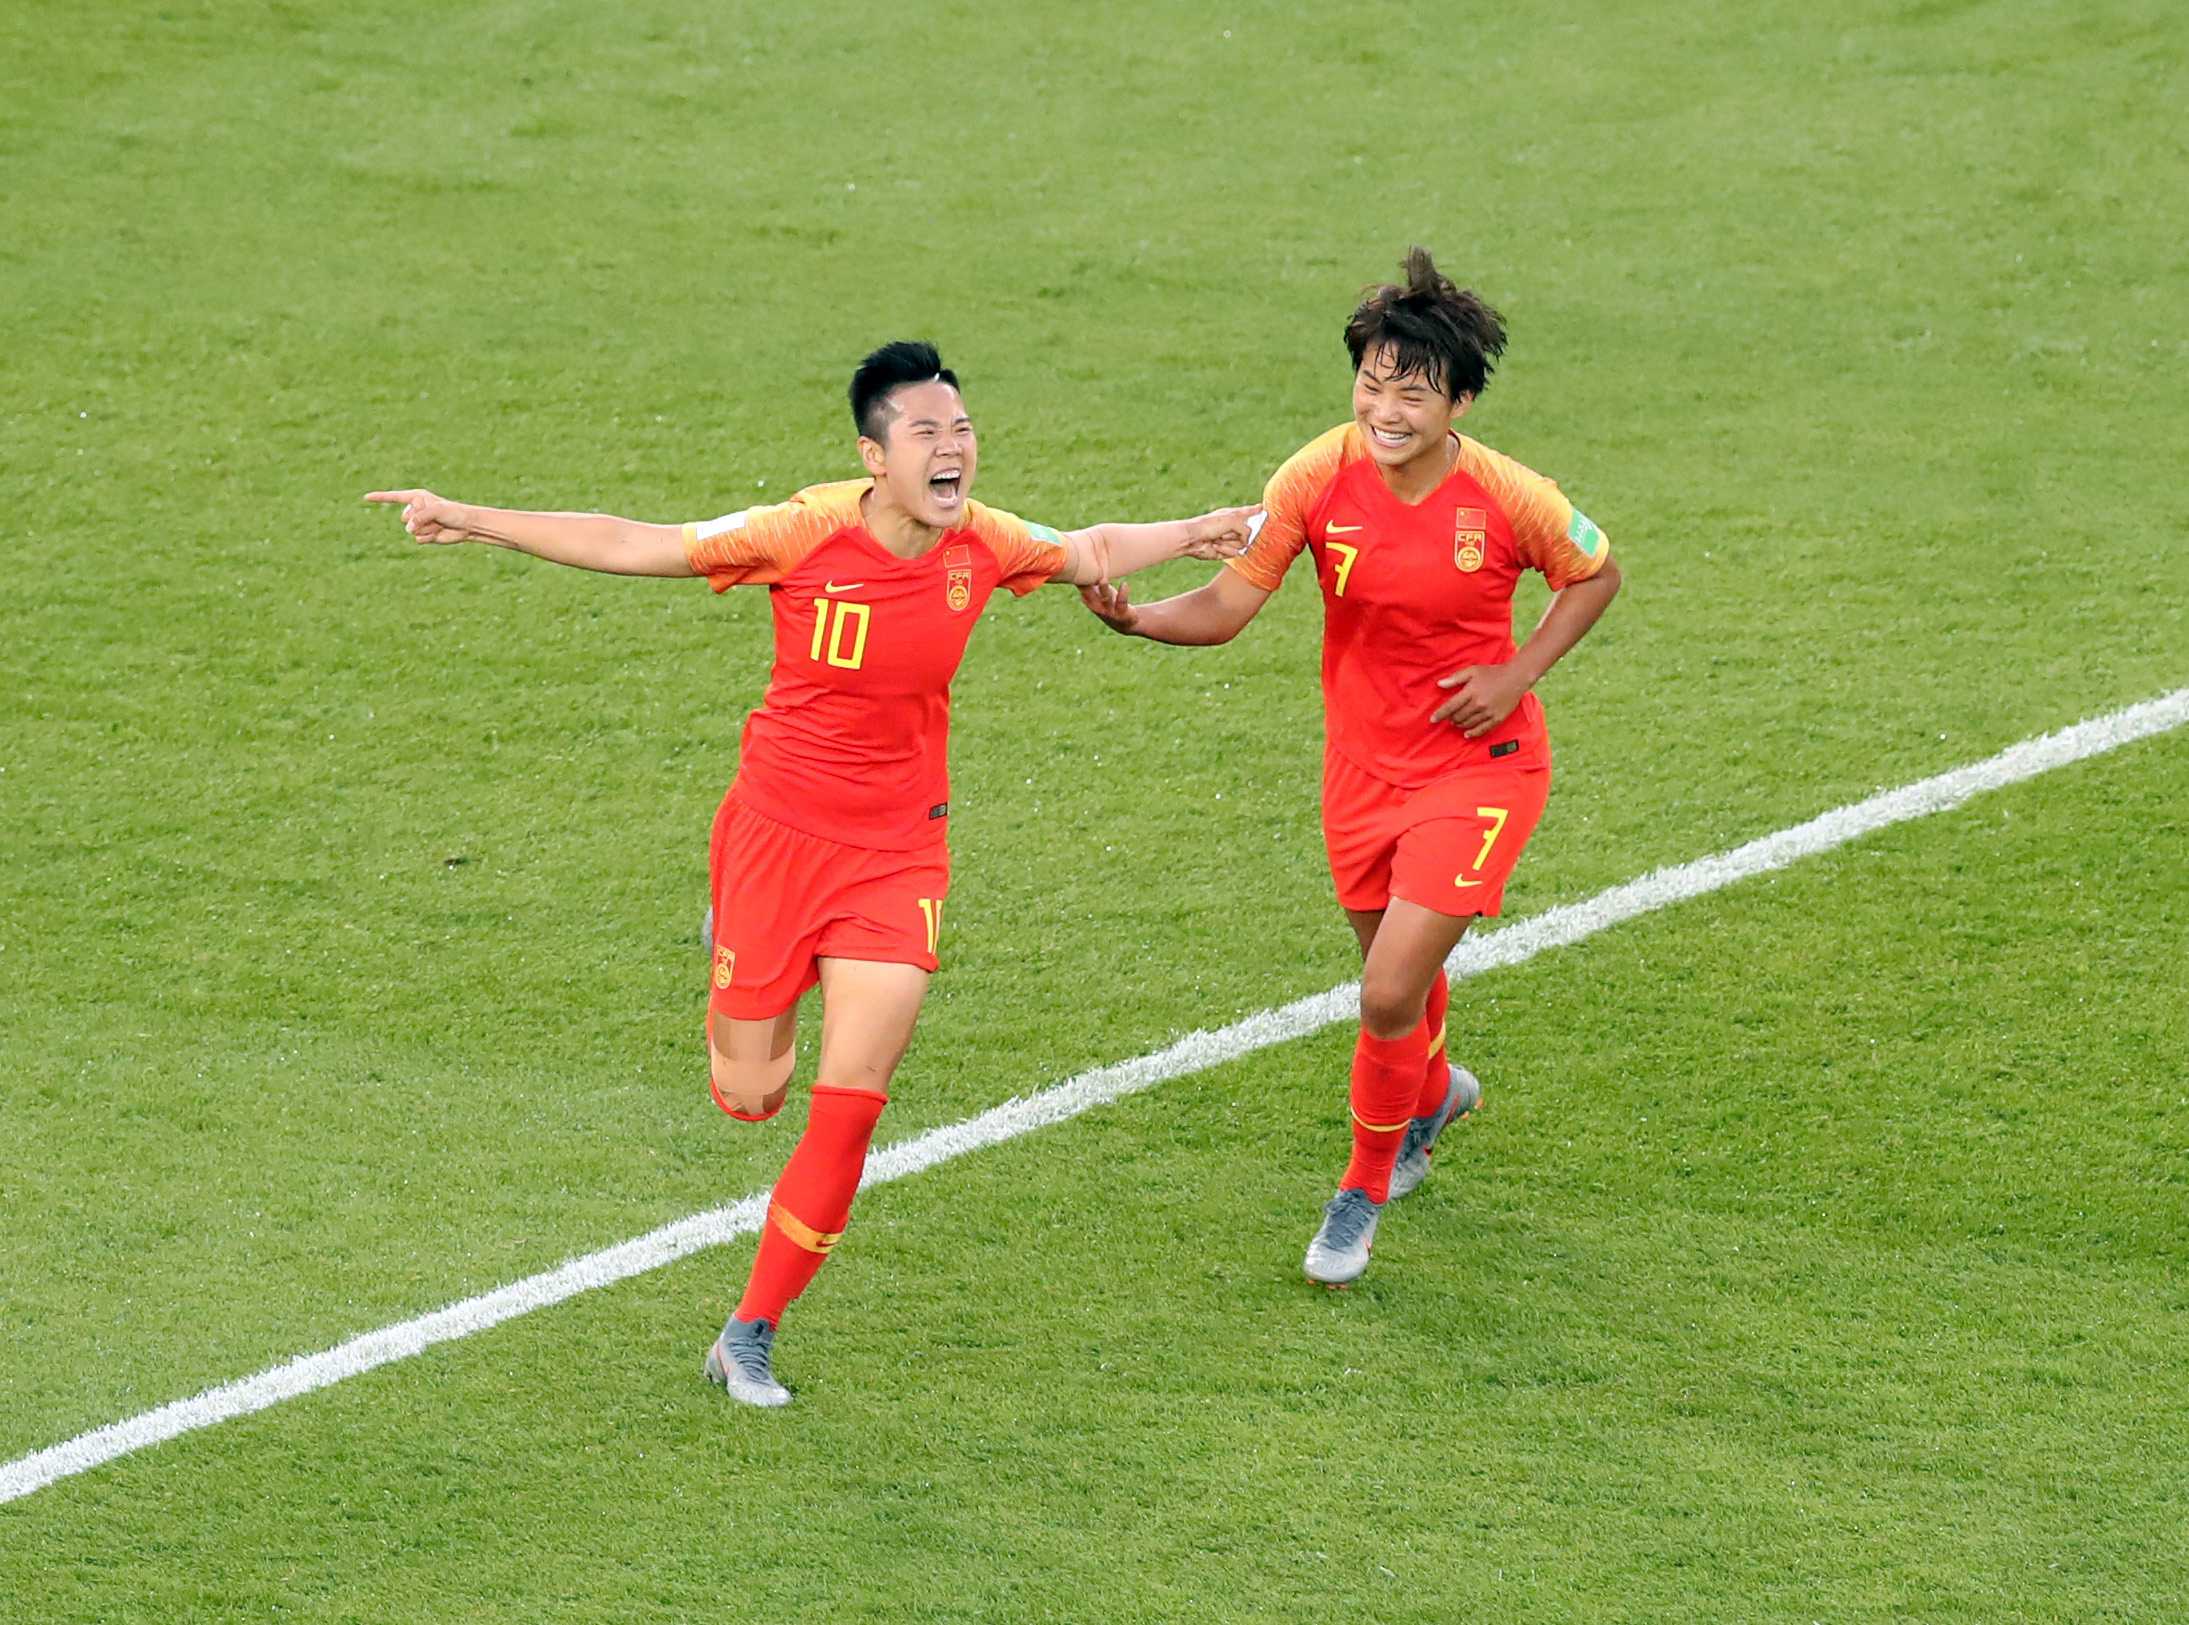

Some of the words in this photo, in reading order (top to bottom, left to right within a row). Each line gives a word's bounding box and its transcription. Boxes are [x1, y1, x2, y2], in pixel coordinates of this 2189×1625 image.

[1457, 533, 1482, 542] CFA
[1325, 541, 1358, 598] 7
[810, 598, 870, 670] 10
[1472, 806, 1509, 871] 7
